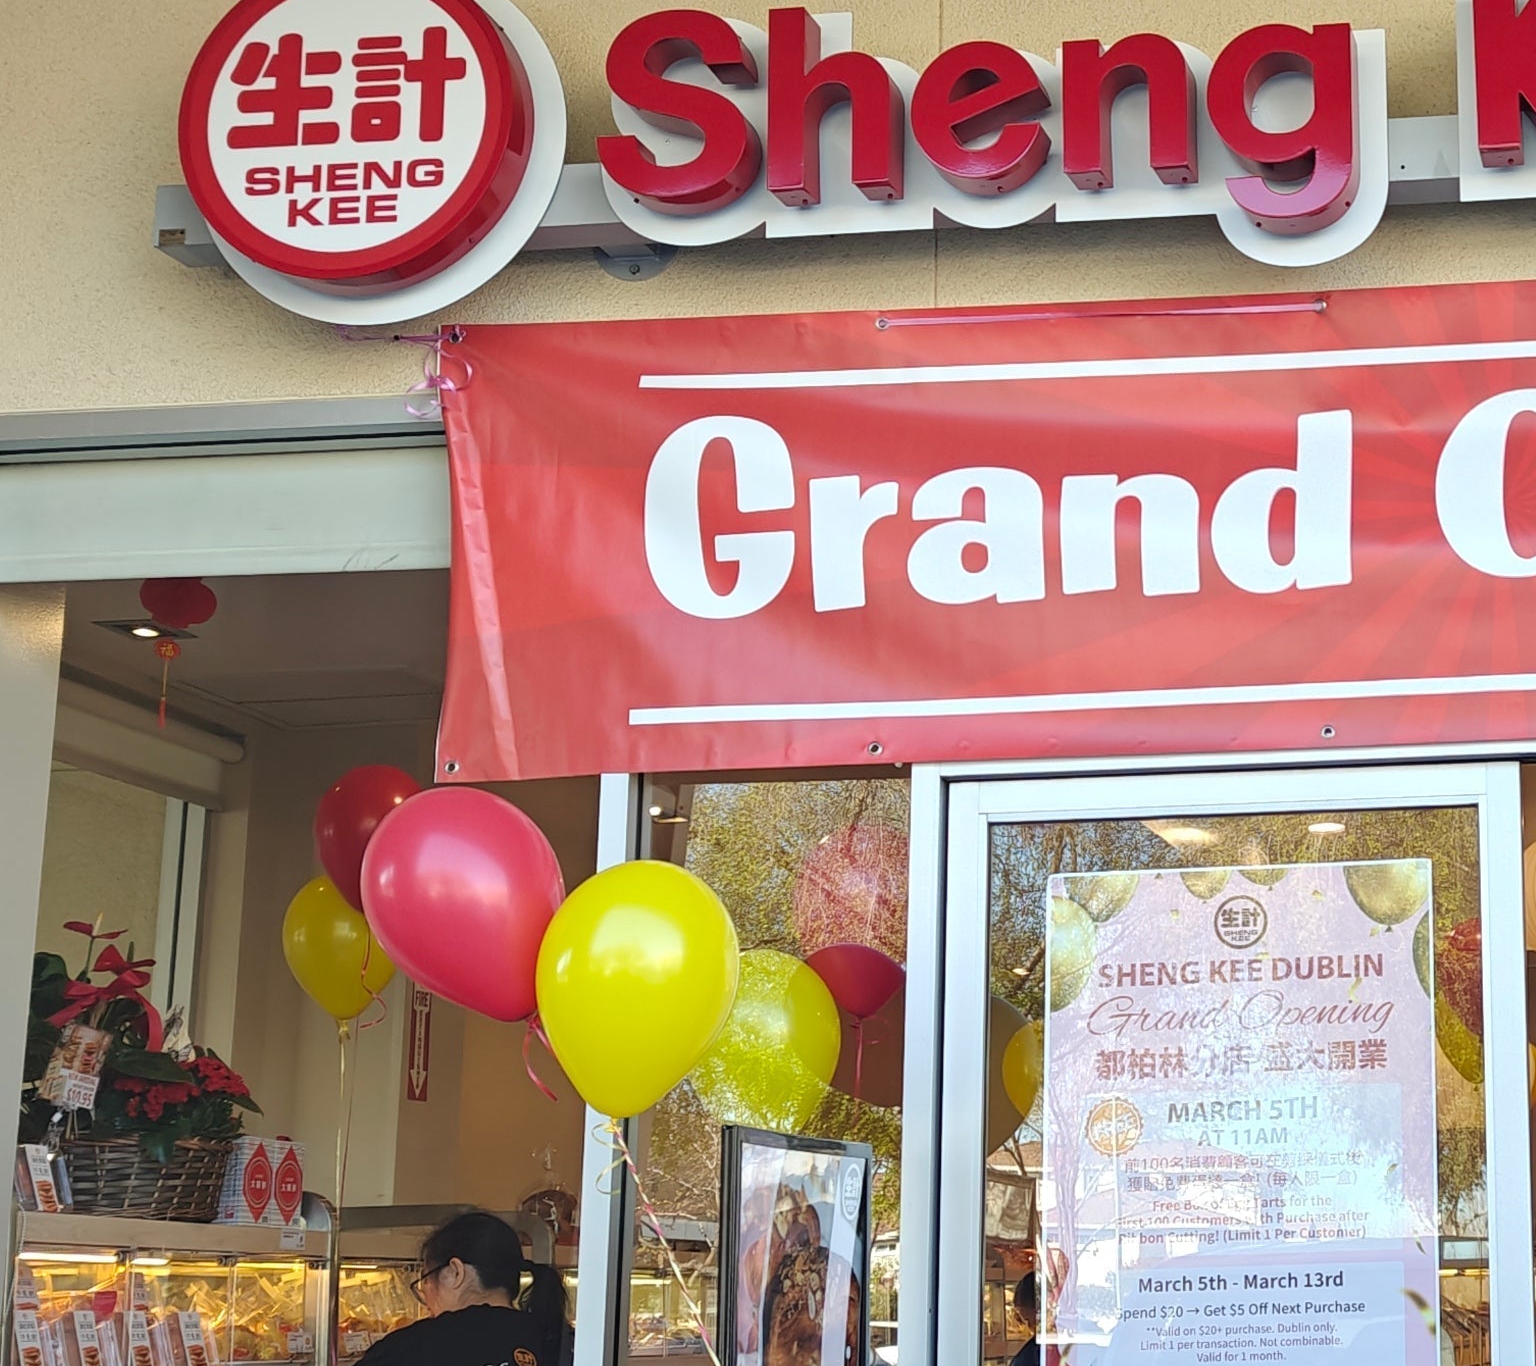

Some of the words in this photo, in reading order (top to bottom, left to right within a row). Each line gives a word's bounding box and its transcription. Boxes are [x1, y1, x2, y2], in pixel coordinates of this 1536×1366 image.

[226, 25, 467, 150] 生計
[596, 5, 1364, 235] Sheng
[244, 157, 445, 197] SHENG
[286, 192, 399, 228] KEE
[643, 409, 1355, 621] Grand
[1220, 907, 1260, 928] 生計
[1223, 929, 1258, 937] SHENG
[1098, 959, 1201, 988] SHENG
[1208, 958, 1263, 985] KEE
[1271, 953, 1384, 982] DUBLIN
[1086, 995, 1230, 1042] Grand
[1238, 989, 1395, 1036] Opening
[1167, 1099, 1262, 1124] MARCH
[1268, 1095, 1319, 1120] 5TH
[1197, 1128, 1225, 1147] AT
[1231, 1126, 1289, 1146] 11AM
[1152, 1199, 1181, 1213] Free
[1289, 1193, 1309, 1207] for
[1311, 1193, 1332, 1207] the
[1276, 1210, 1337, 1226] Purchase
[1338, 1208, 1369, 1223] after
[1223, 1227, 1262, 1244] (Limit
[1264, 1228, 1271, 1242] 1
[1274, 1227, 1297, 1241] Per
[1299, 1224, 1367, 1241] Customer)
[1138, 1274, 1193, 1294] March
[1197, 1273, 1228, 1292] 5th
[1243, 1271, 1299, 1290] March
[1303, 1269, 1345, 1288] 13rd
[1160, 1305, 1184, 1319] $20
[1203, 1303, 1227, 1317] Get
[1229, 1302, 1245, 1317] $5
[1248, 1302, 1269, 1316] Off
[1271, 1301, 1302, 1315] Next
[1304, 1299, 1366, 1314] Purchase
[1183, 1326, 1196, 1337] on
[1198, 1324, 1222, 1337] $20+
[1225, 1322, 1275, 1337] purchase.
[1277, 1321, 1311, 1334] Dublin
[1312, 1321, 1338, 1335] only.
[1140, 1338, 1167, 1351] Limit
[1169, 1339, 1175, 1351] 1
[1177, 1339, 1194, 1352] per
[1196, 1335, 1257, 1350] transaction.
[1259, 1336, 1278, 1348] Not
[1280, 1334, 1344, 1348] combinable.
[1196, 1351, 1222, 1363] Valid
[1224, 1350, 1239, 1363] for
[1241, 1350, 1247, 1362] 1
[1249, 1349, 1287, 1362] month.
